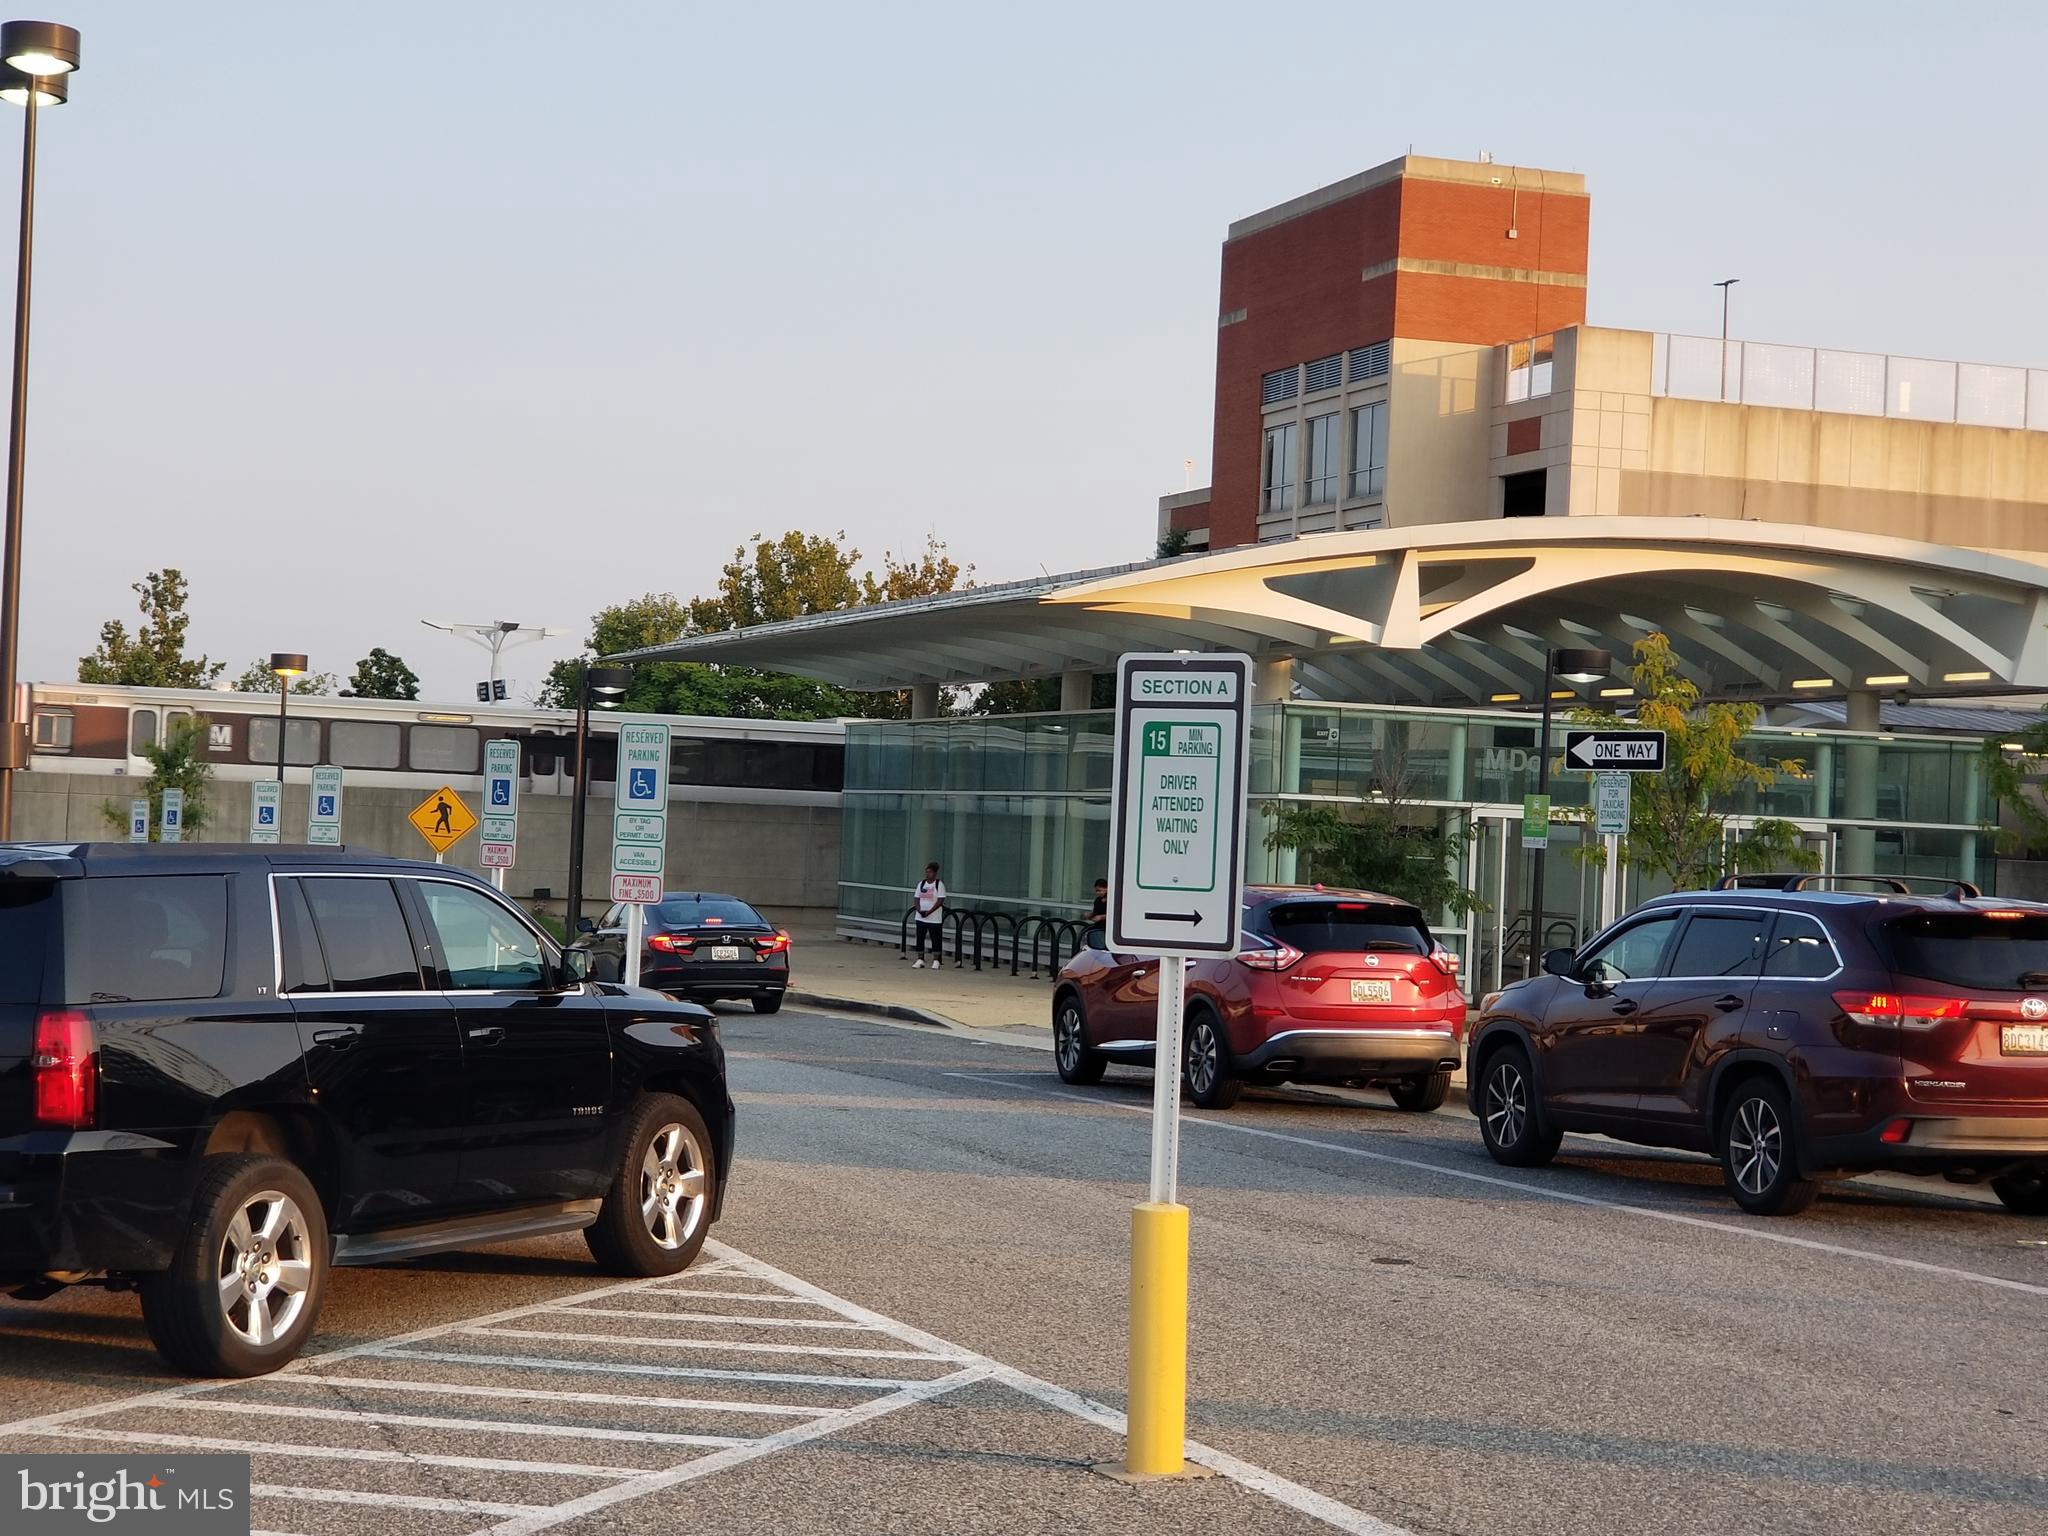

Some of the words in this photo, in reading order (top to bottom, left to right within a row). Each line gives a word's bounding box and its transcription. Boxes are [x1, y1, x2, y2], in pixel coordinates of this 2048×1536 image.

[1142, 680, 1212, 695] SECTION
[1217, 681, 1228, 695] A
[625, 731, 664, 744] RESERVED
[1149, 730, 1167, 750] 15
[1188, 729, 1203, 741] MIN
[490, 748, 516, 759] RESERVED
[1178, 742, 1213, 755] PARKING
[1595, 743, 1621, 758] ONE
[1626, 743, 1653, 759] WAY
[628, 749, 660, 762] PARKING
[491, 763, 513, 774] PARKING
[1160, 775, 1197, 790] DRIVER
[1600, 778, 1628, 788] RESERVED
[1608, 789, 1619, 799] FOR
[1151, 796, 1204, 812] ATTENDED
[1602, 800, 1624, 809] TAXICAB
[1600, 810, 1626, 820] STANDING
[1156, 817, 1198, 833] WAITING
[1163, 839, 1189, 855] ONLY
[619, 858, 657, 866] ACCESSIBLE
[622, 878, 652, 889] MAXIMUM
[618, 888, 633, 899] FINE
[637, 889, 654, 900] $500
